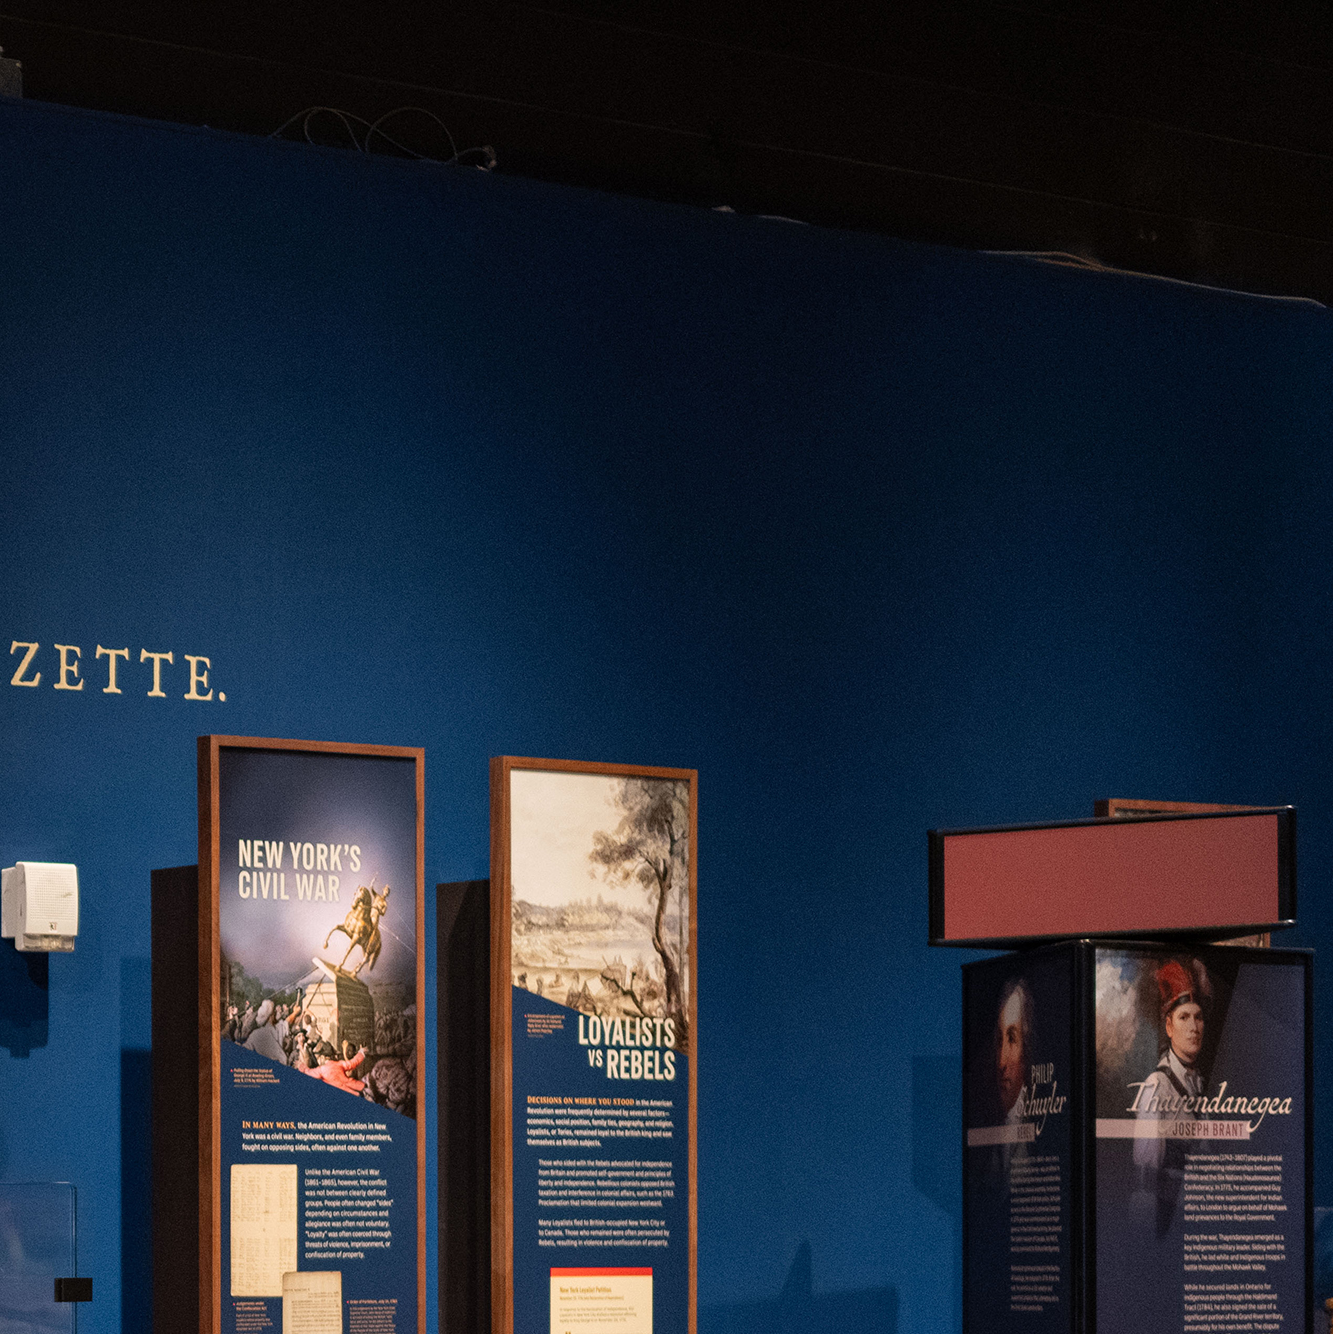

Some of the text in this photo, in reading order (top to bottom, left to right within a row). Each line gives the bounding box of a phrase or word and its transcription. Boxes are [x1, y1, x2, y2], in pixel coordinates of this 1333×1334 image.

[238, 838, 362, 873] NEW YORK'S
[238, 870, 341, 902] CIVIL WAR
[578, 1014, 676, 1048] LOYALISTS
[588, 1048, 676, 1081] VS REBELS
[1031, 1062, 1055, 1085] PHILIP
[526, 1095, 635, 1106] DECISIONS ON WHERE YOU STOOD
[1016, 1080, 1067, 1136] Schuyler
[1126, 1080, 1293, 1133] Thayendanegea
[241, 1120, 387, 1131] IN MANY WAYS, the American Revolution in New
[1172, 1122, 1244, 1138] JOSEPH BRANT
